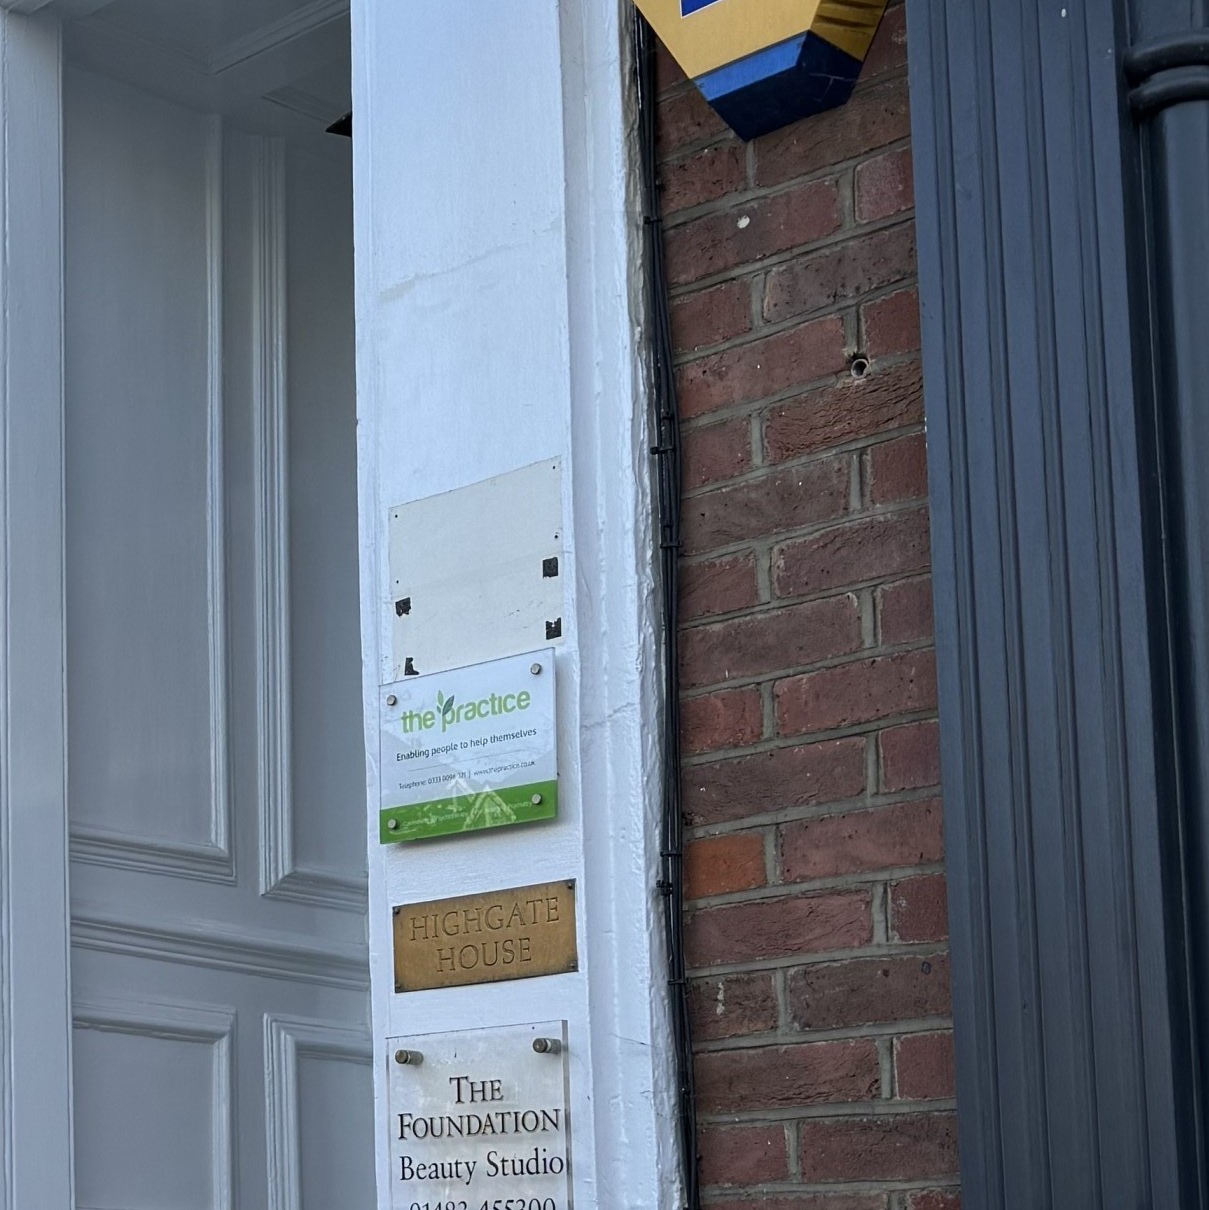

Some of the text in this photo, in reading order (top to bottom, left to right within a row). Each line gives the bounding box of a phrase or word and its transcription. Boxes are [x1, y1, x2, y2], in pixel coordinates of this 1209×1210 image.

[400, 690, 531, 734] the practice
[396, 728, 537, 762] Enabling people to help themselves
[409, 896, 560, 941] HIGHGATE
[436, 937, 532, 973] HOUSE
[397, 1108, 561, 1140] FOUNDATION
[399, 1147, 564, 1186] Beauty Studio
